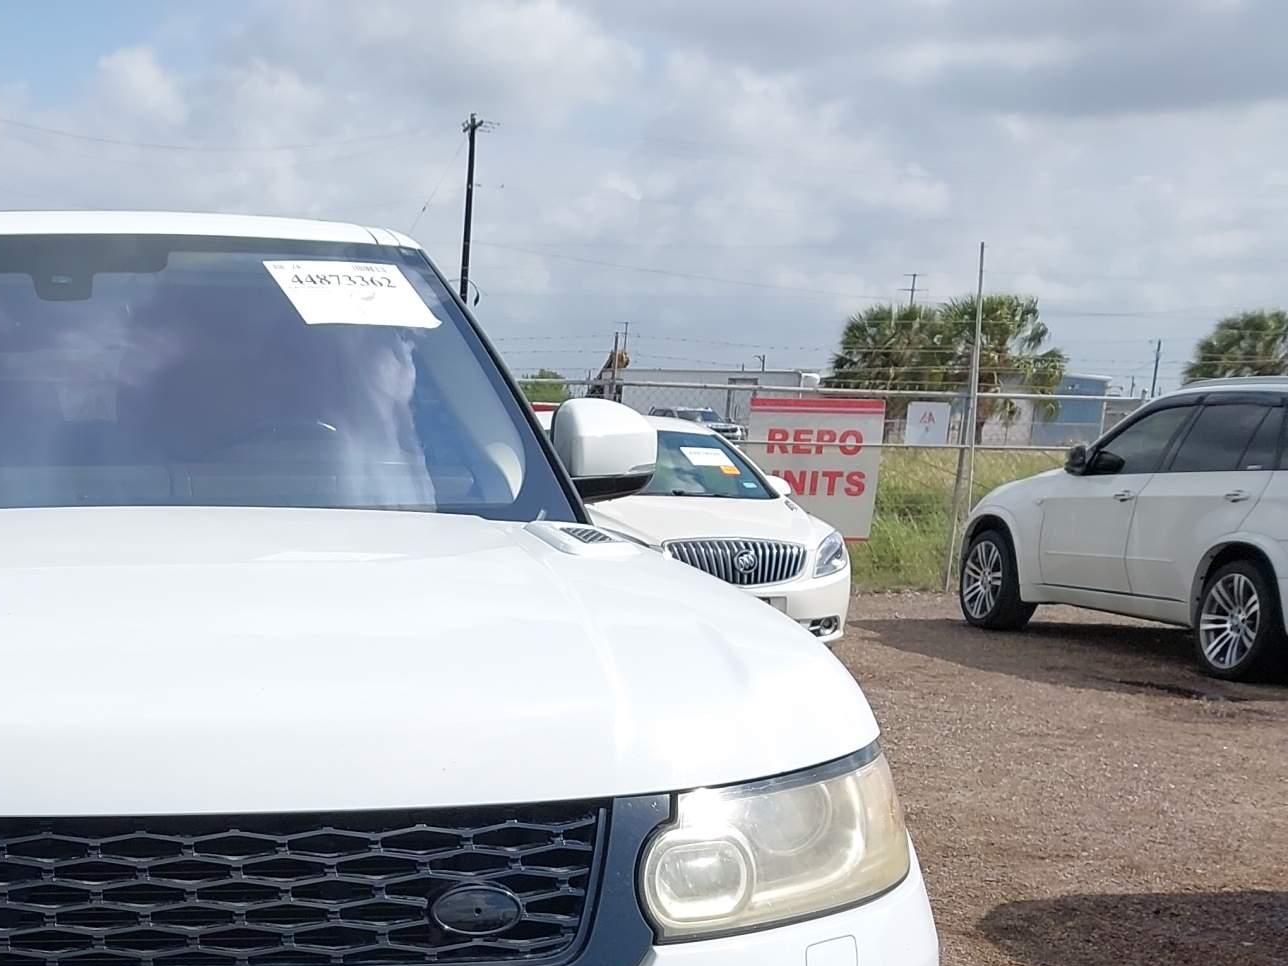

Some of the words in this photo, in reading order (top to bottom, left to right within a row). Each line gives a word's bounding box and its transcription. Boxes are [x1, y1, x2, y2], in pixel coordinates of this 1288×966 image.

[291, 273, 397, 288] 44873362
[767, 428, 864, 456] REPO
[772, 470, 866, 497] NITS
